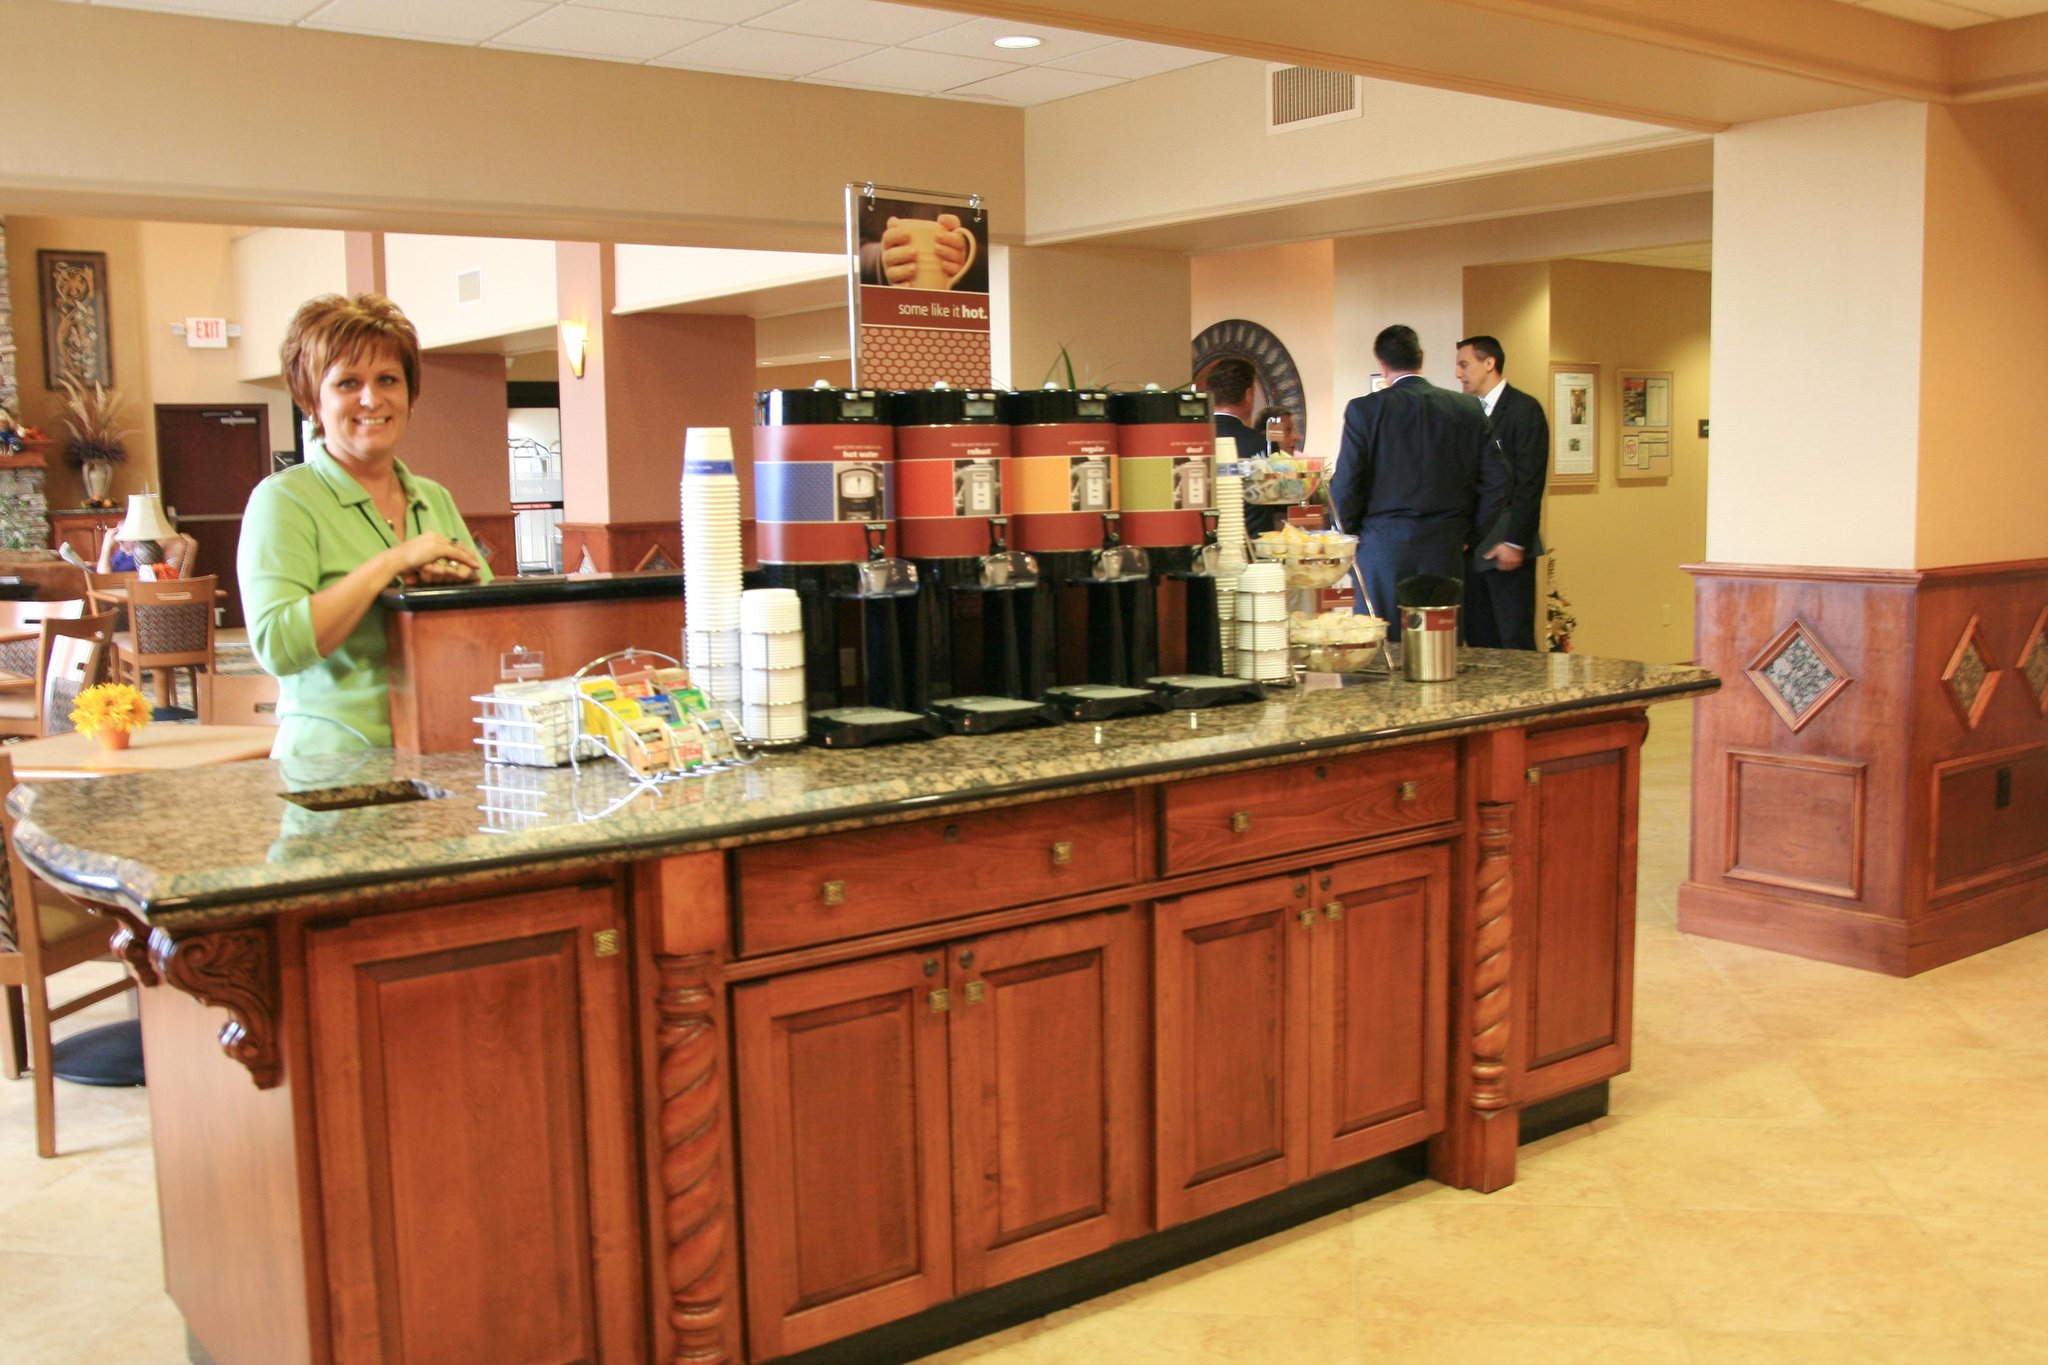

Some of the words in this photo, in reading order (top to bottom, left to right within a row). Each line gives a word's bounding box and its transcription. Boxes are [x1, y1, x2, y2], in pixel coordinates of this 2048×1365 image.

[898, 303, 929, 317] some
[931, 302, 950, 317] like
[952, 304, 961, 318] it
[961, 304, 988, 319] hot.
[195, 319, 220, 339] EXIT
[842, 450, 858, 458] hot
[966, 447, 992, 456] robust
[1080, 446, 1105, 454] regular
[1185, 446, 1204, 454] decaf
